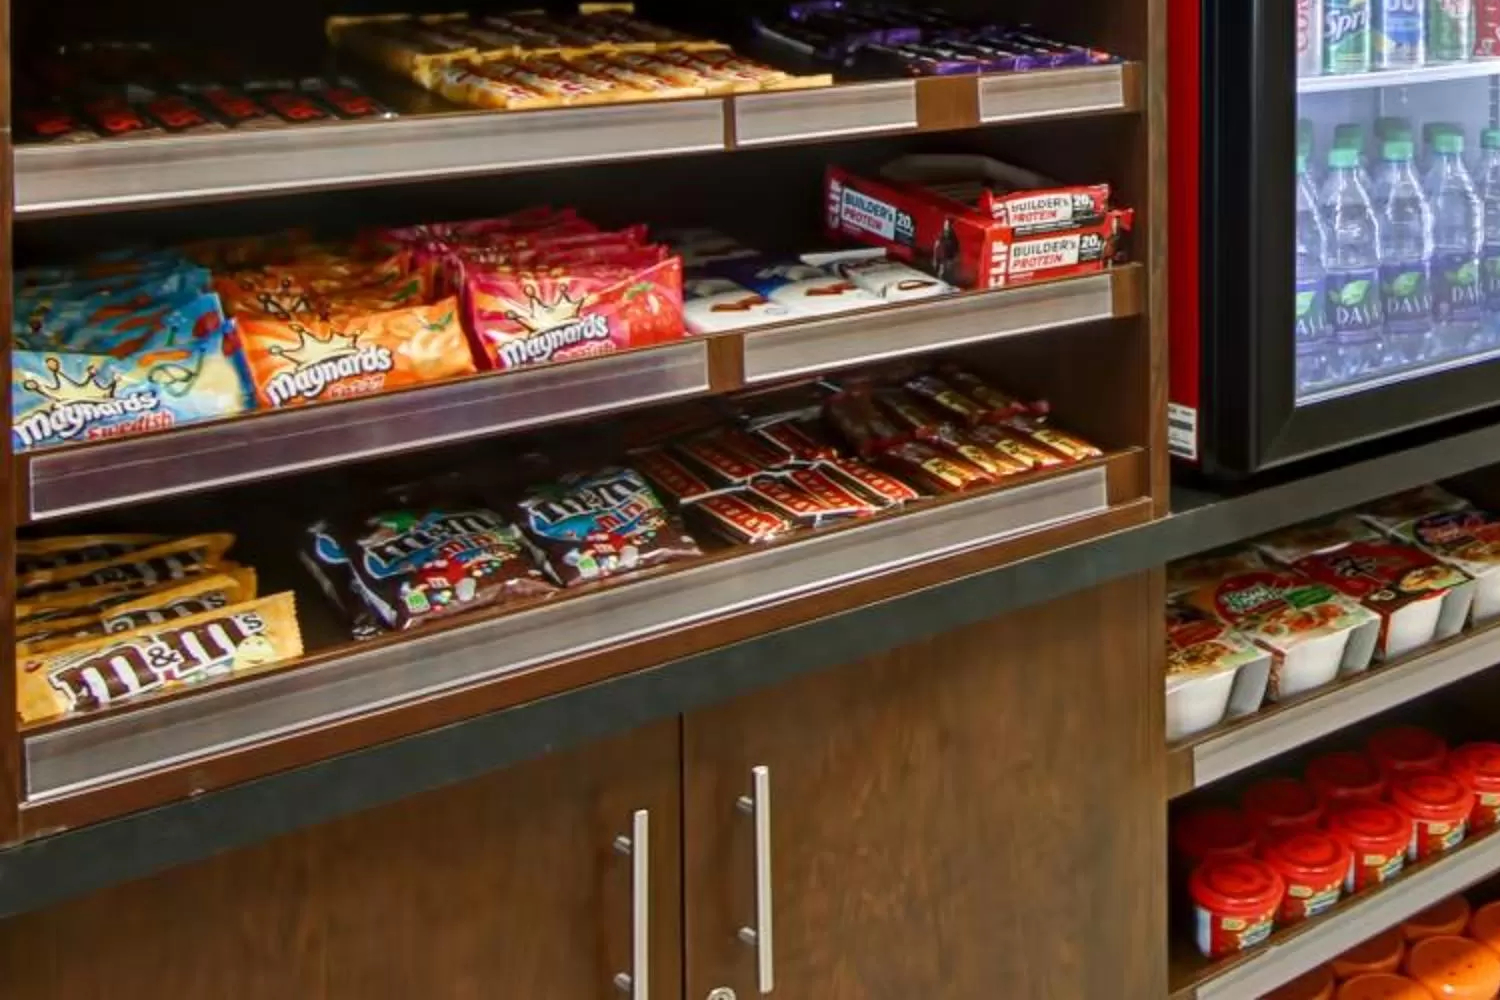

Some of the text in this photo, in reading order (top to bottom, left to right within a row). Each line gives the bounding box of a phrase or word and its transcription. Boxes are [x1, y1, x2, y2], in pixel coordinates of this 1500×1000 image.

[1012, 253, 1064, 270] PROTEIN
[500, 313, 609, 368] Maynards
[266, 344, 393, 406] Maynards
[12, 388, 158, 446] Maynards
